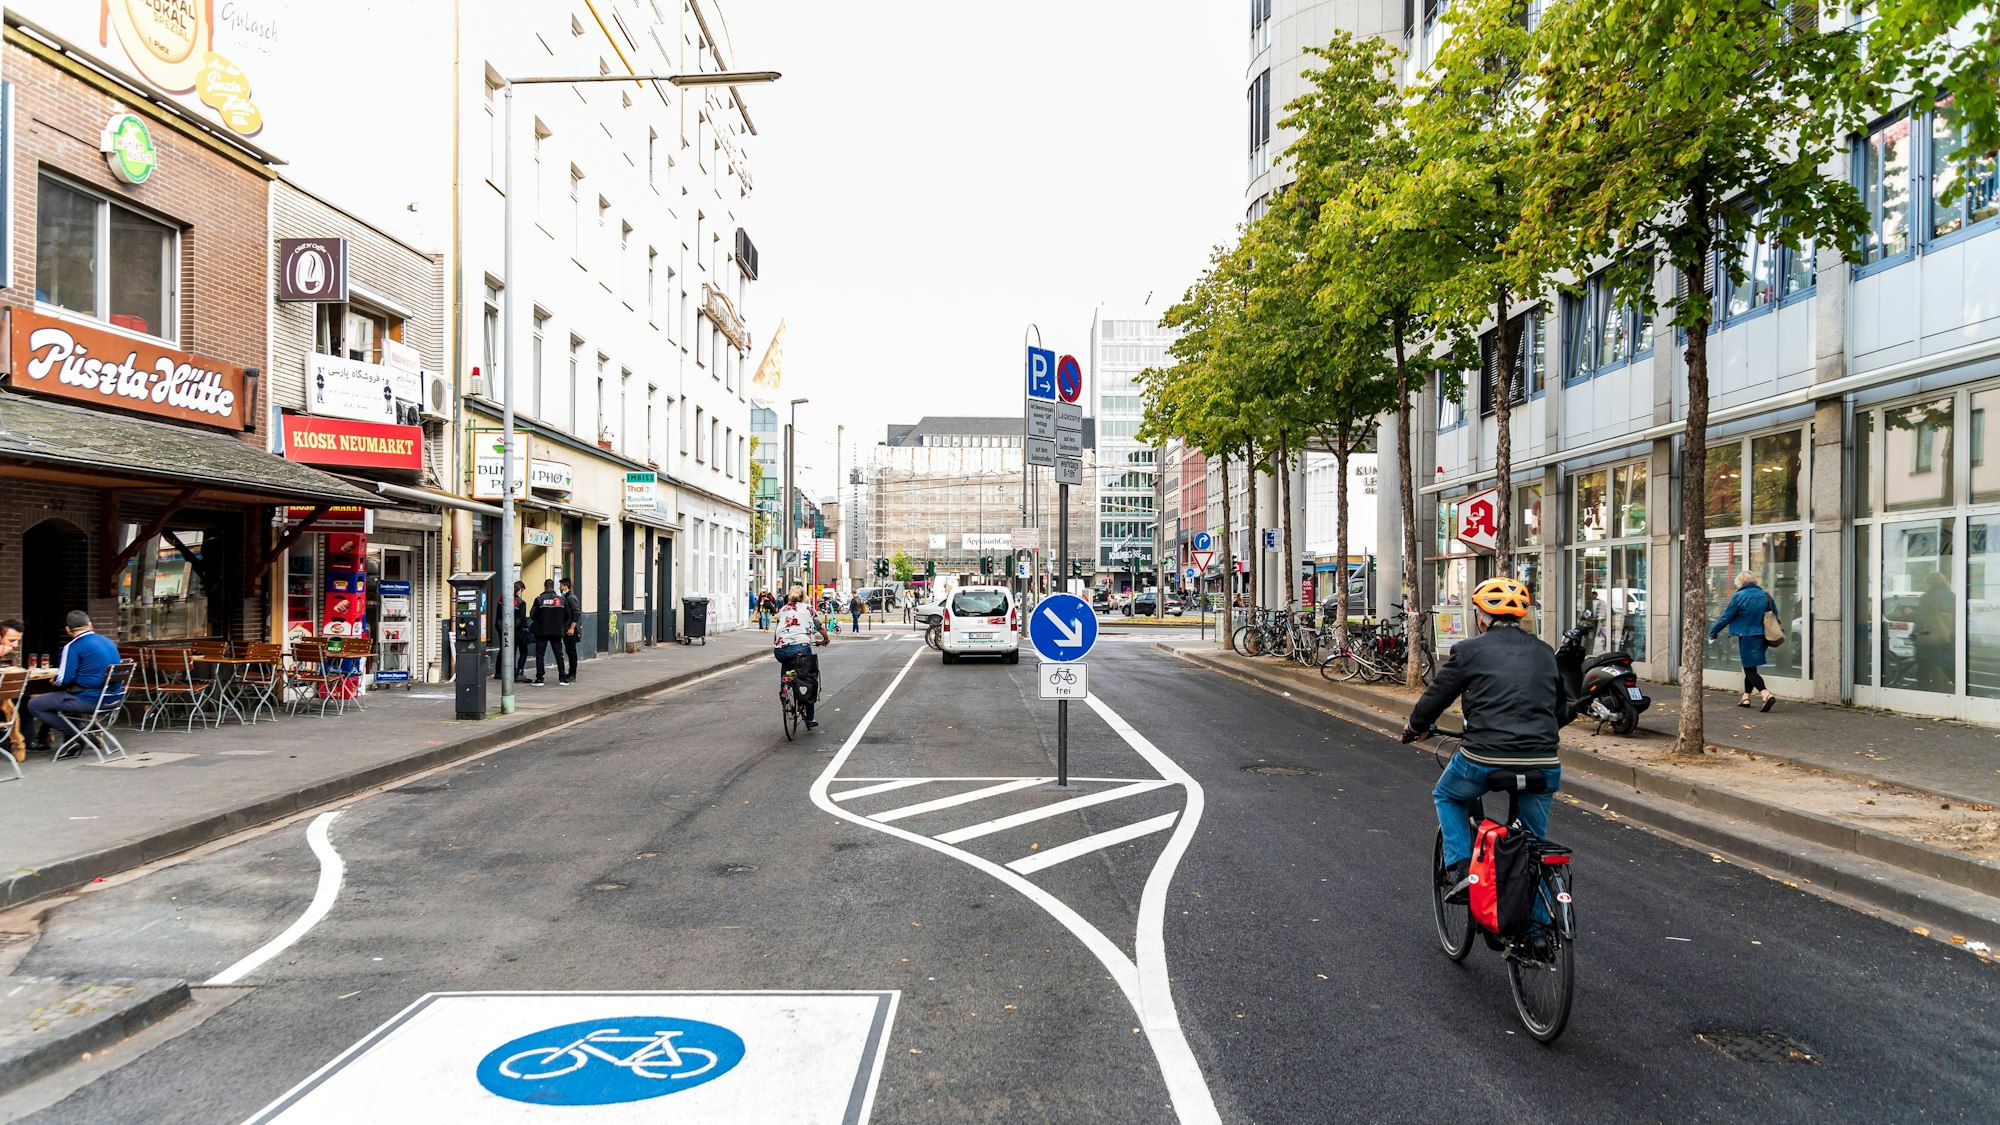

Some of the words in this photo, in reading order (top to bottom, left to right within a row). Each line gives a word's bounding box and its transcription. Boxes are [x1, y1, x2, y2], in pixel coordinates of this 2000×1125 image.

[153, 11, 189, 41] SPEZIAL
[154, 40, 170, 54] Platz
[1032, 353, 1047, 390] P
[1058, 411, 1080, 423] Ladezone
[292, 430, 338, 450] KIOSK
[339, 434, 414, 456] NEUMARKT
[627, 473, 655, 481] IMBISS
[627, 485, 644, 493] Thai
[1055, 686, 1072, 695] frei
